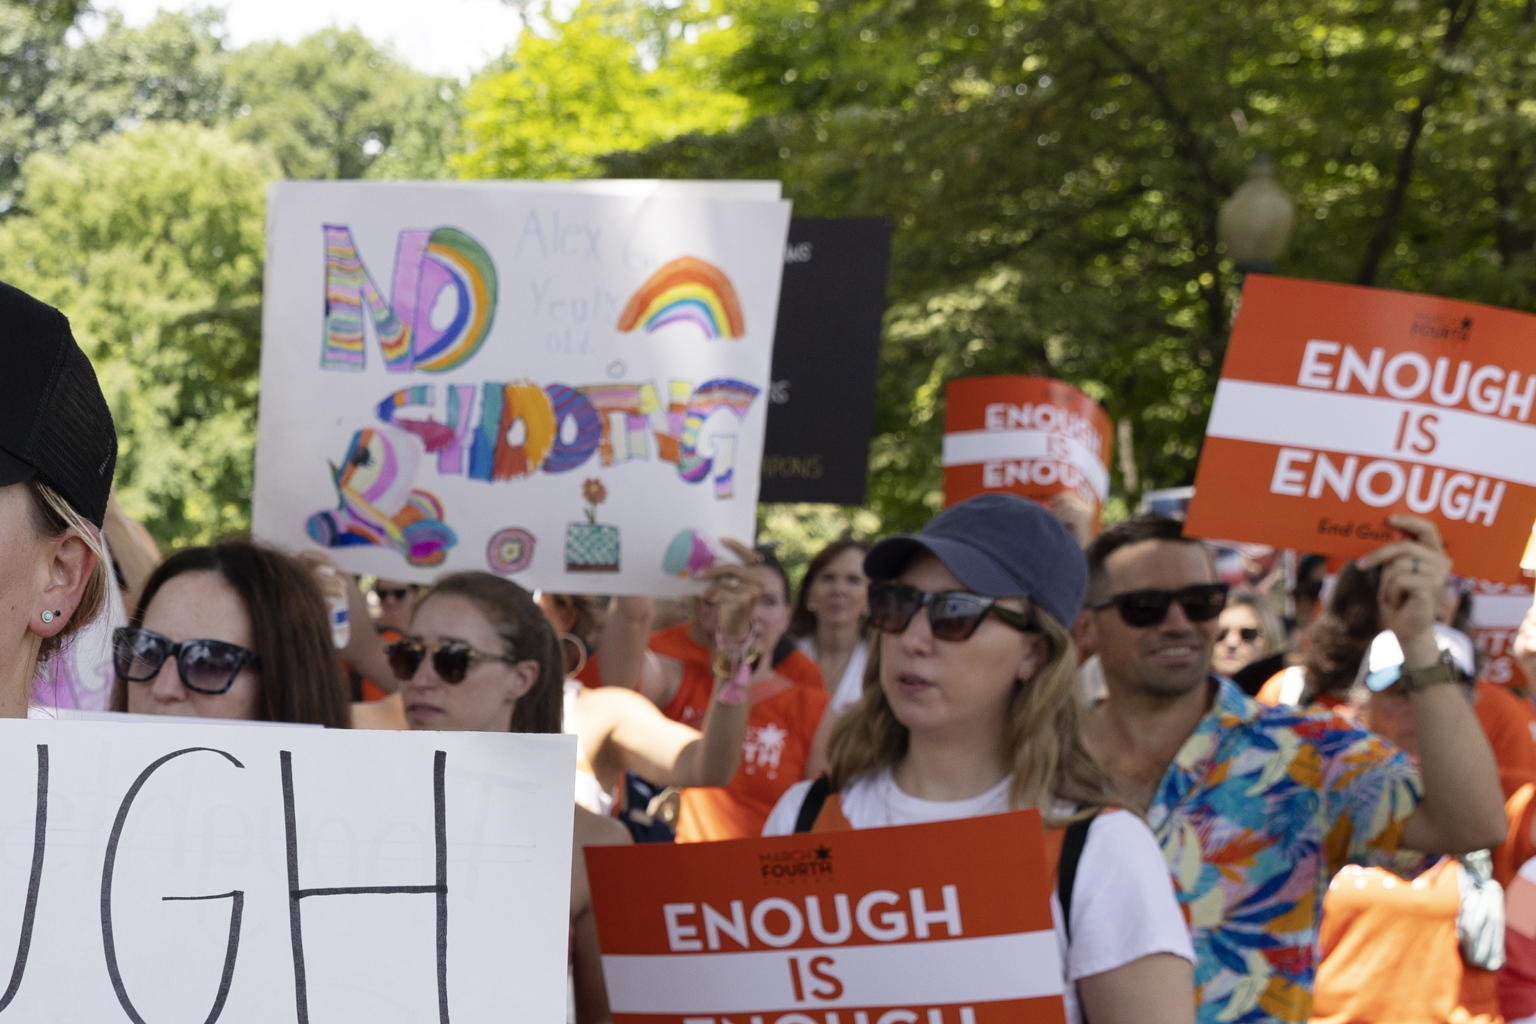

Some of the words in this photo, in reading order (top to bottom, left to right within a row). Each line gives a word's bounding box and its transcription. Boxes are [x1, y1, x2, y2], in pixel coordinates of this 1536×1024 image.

[1297, 338, 1536, 421] ENOUGH
[1391, 410, 1440, 455] IS
[1270, 447, 1506, 527] ENOUGH
[663, 884, 963, 951] ENOUGH
[787, 955, 844, 1001] IS
